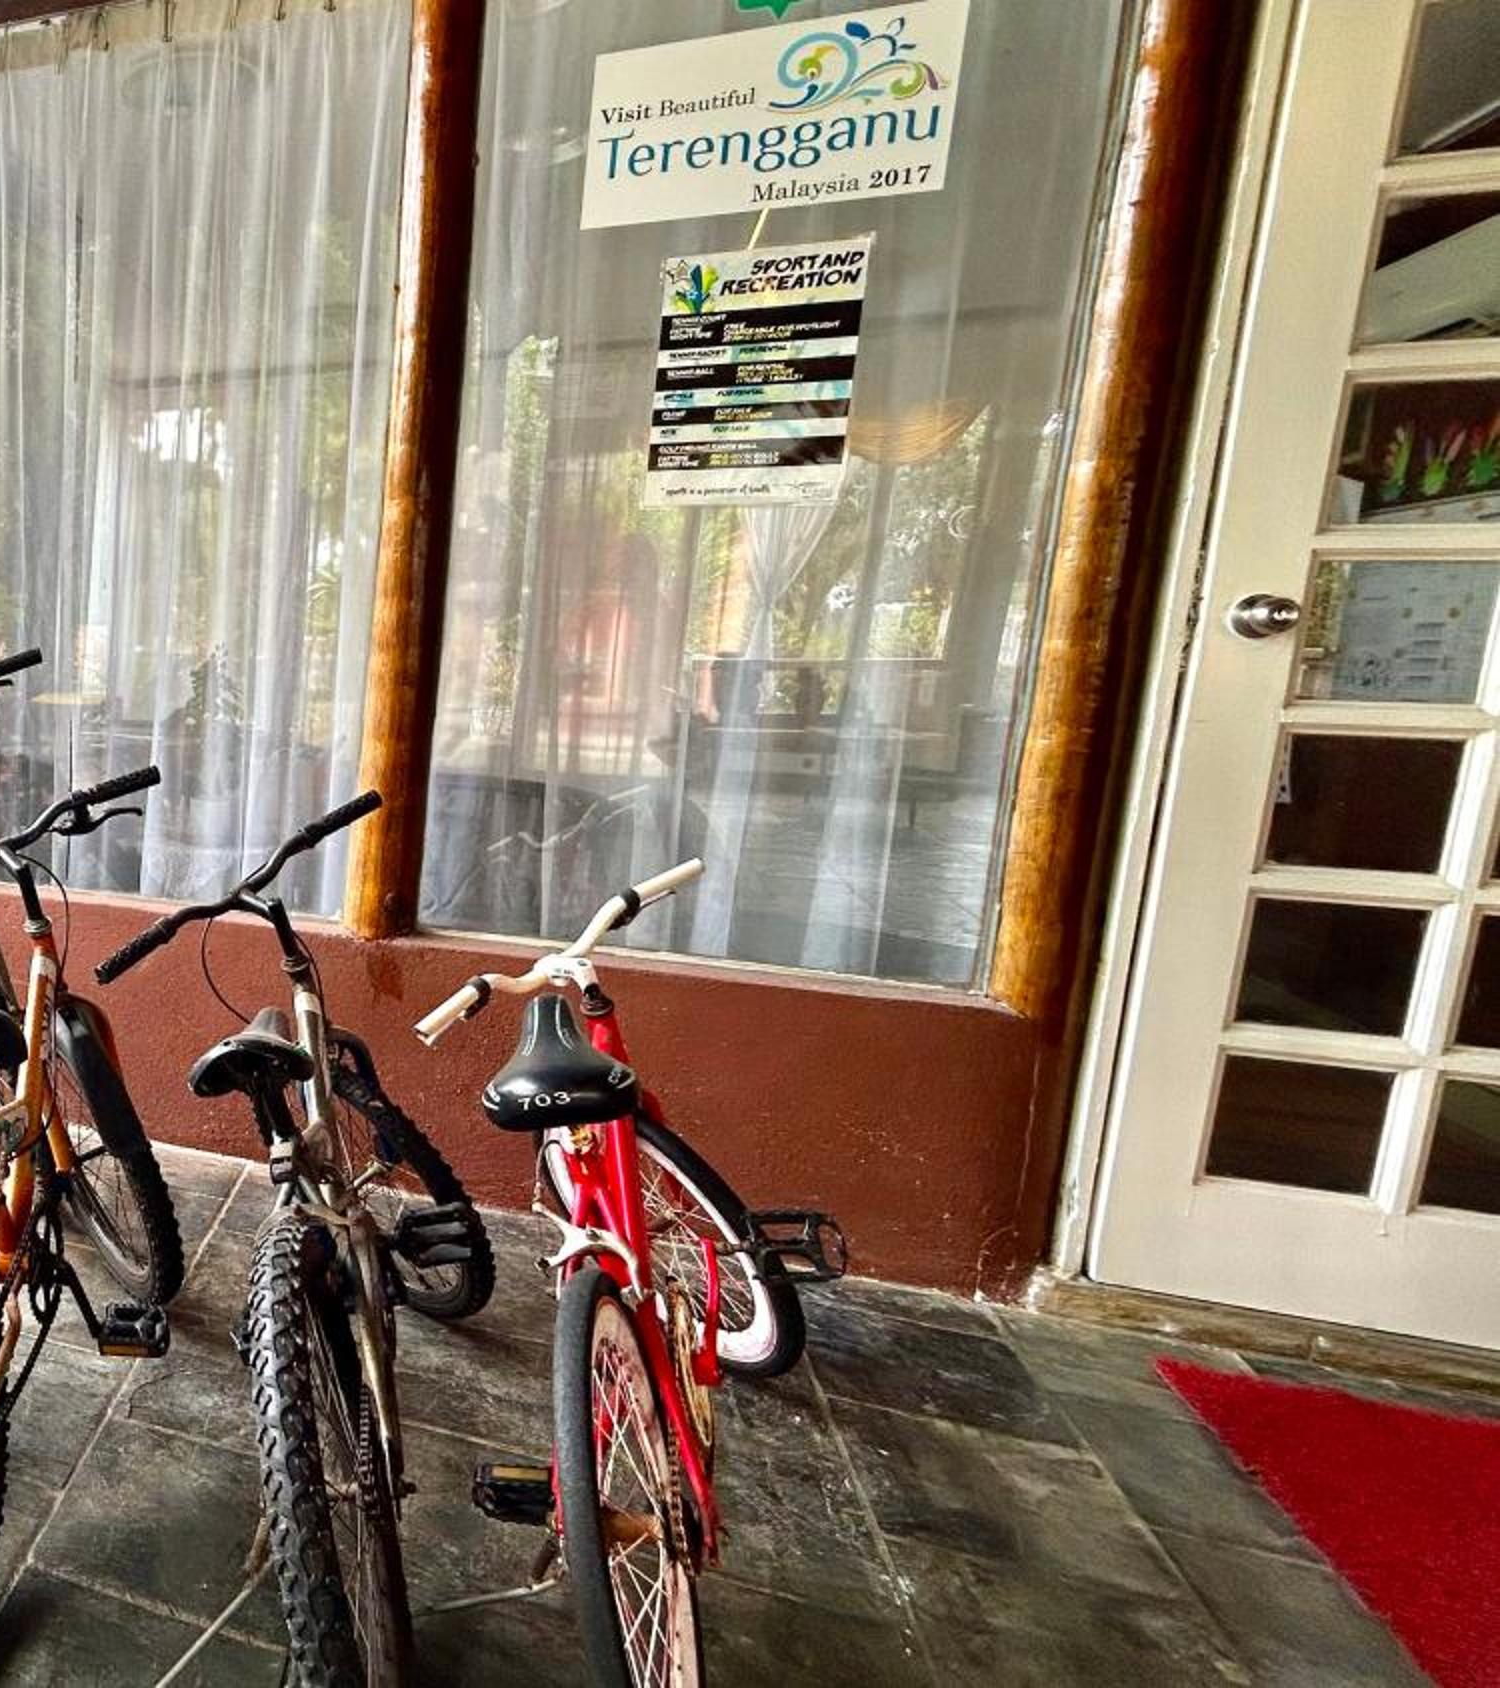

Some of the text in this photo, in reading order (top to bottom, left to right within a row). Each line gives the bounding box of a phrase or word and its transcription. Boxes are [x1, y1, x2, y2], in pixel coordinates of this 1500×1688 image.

[601, 88, 755, 125] Visit Beautiful
[597, 105, 941, 180] Terengganu
[751, 165, 931, 203] Malaysia 2017
[751, 251, 865, 275] SPORT AND
[719, 267, 863, 296] RECREATION
[517, 1091, 571, 1111] 703
